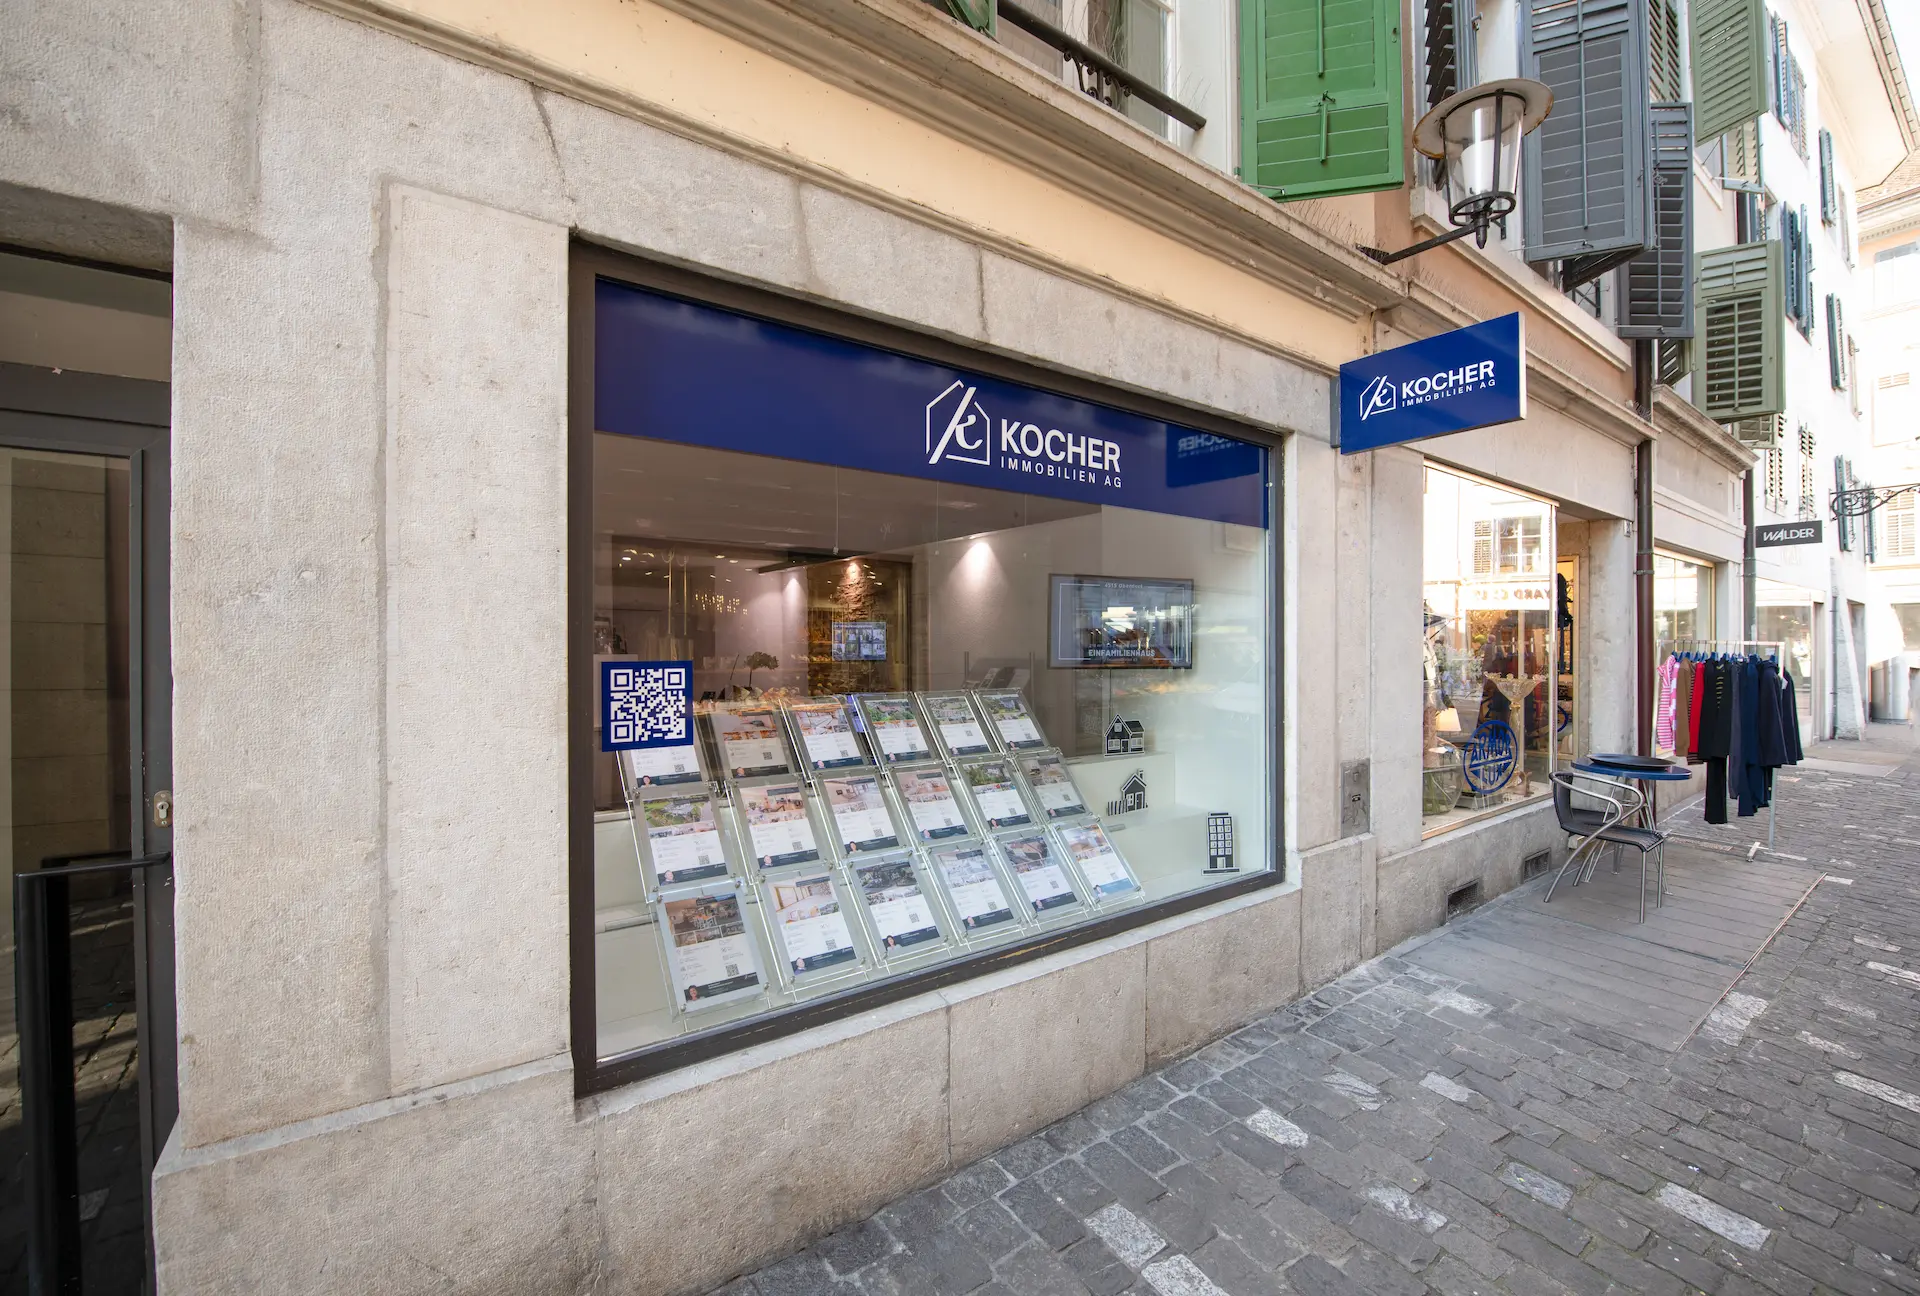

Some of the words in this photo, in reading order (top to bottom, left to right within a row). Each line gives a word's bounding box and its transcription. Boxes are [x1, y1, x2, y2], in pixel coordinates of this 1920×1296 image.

[1402, 360, 1495, 399] KOCHER
[1402, 384, 1473, 407] IMMOBILIEN
[1480, 379, 1496, 391] AG
[1001, 418, 1121, 473] KOCHER
[1001, 456, 1096, 484] IMMOBILIEN
[1104, 475, 1122, 488] AG
[1763, 528, 1815, 542] WALDER
[1088, 649, 1156, 657] EINFAMILIENHAUS
[1471, 728, 1513, 763] ARMOR
[1478, 763, 1508, 786] LUX
